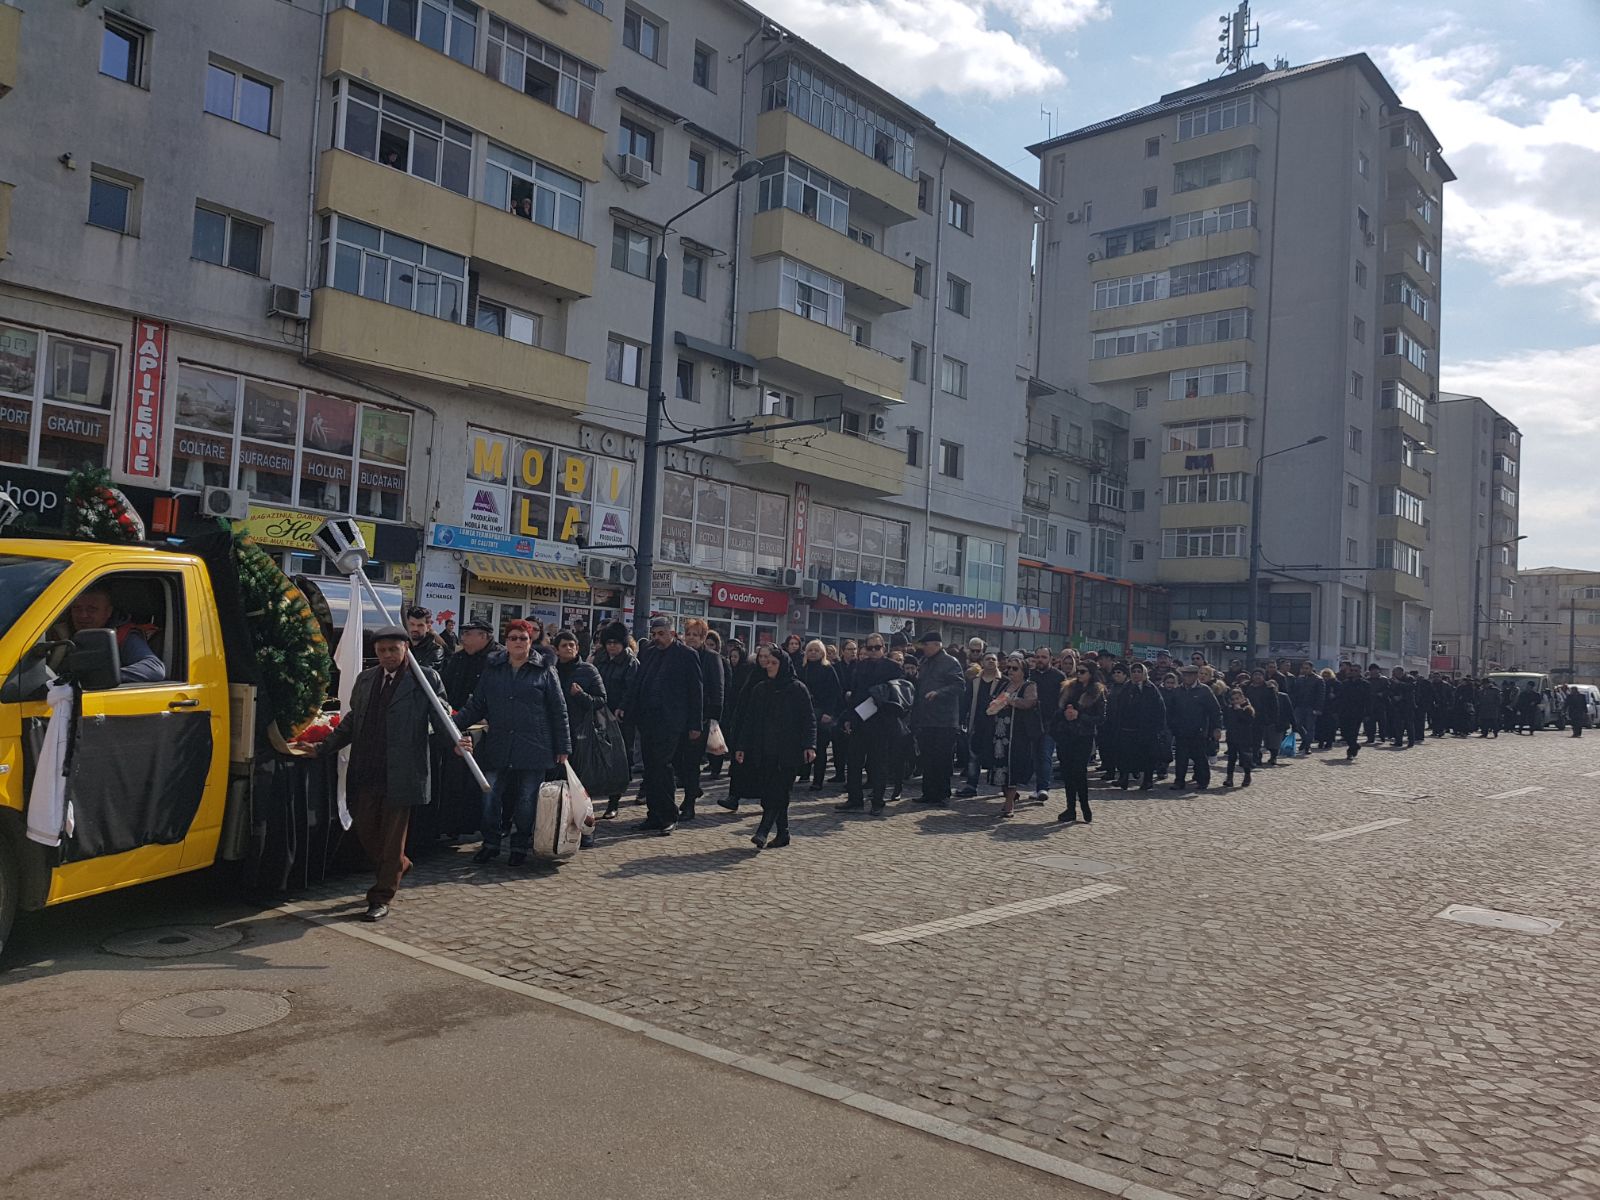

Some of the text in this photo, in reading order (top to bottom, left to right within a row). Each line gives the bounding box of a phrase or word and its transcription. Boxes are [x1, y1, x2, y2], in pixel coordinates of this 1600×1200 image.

[134, 323, 160, 472] TAPITERIE
[47, 415, 102, 438] GRATUIT
[179, 439, 225, 460] COLTARE
[239, 451, 293, 472] SUFRAGERII
[308, 462, 346, 481] HOLURI
[266, 518, 314, 542] Ha
[666, 526, 687, 538] LIVING
[475, 556, 583, 583] EXCHANGE
[534, 587, 557, 598] ACR
[729, 592, 764, 605] vodafone
[821, 583, 847, 606] DAB
[869, 591, 1041, 630] Complex comercial DAB
